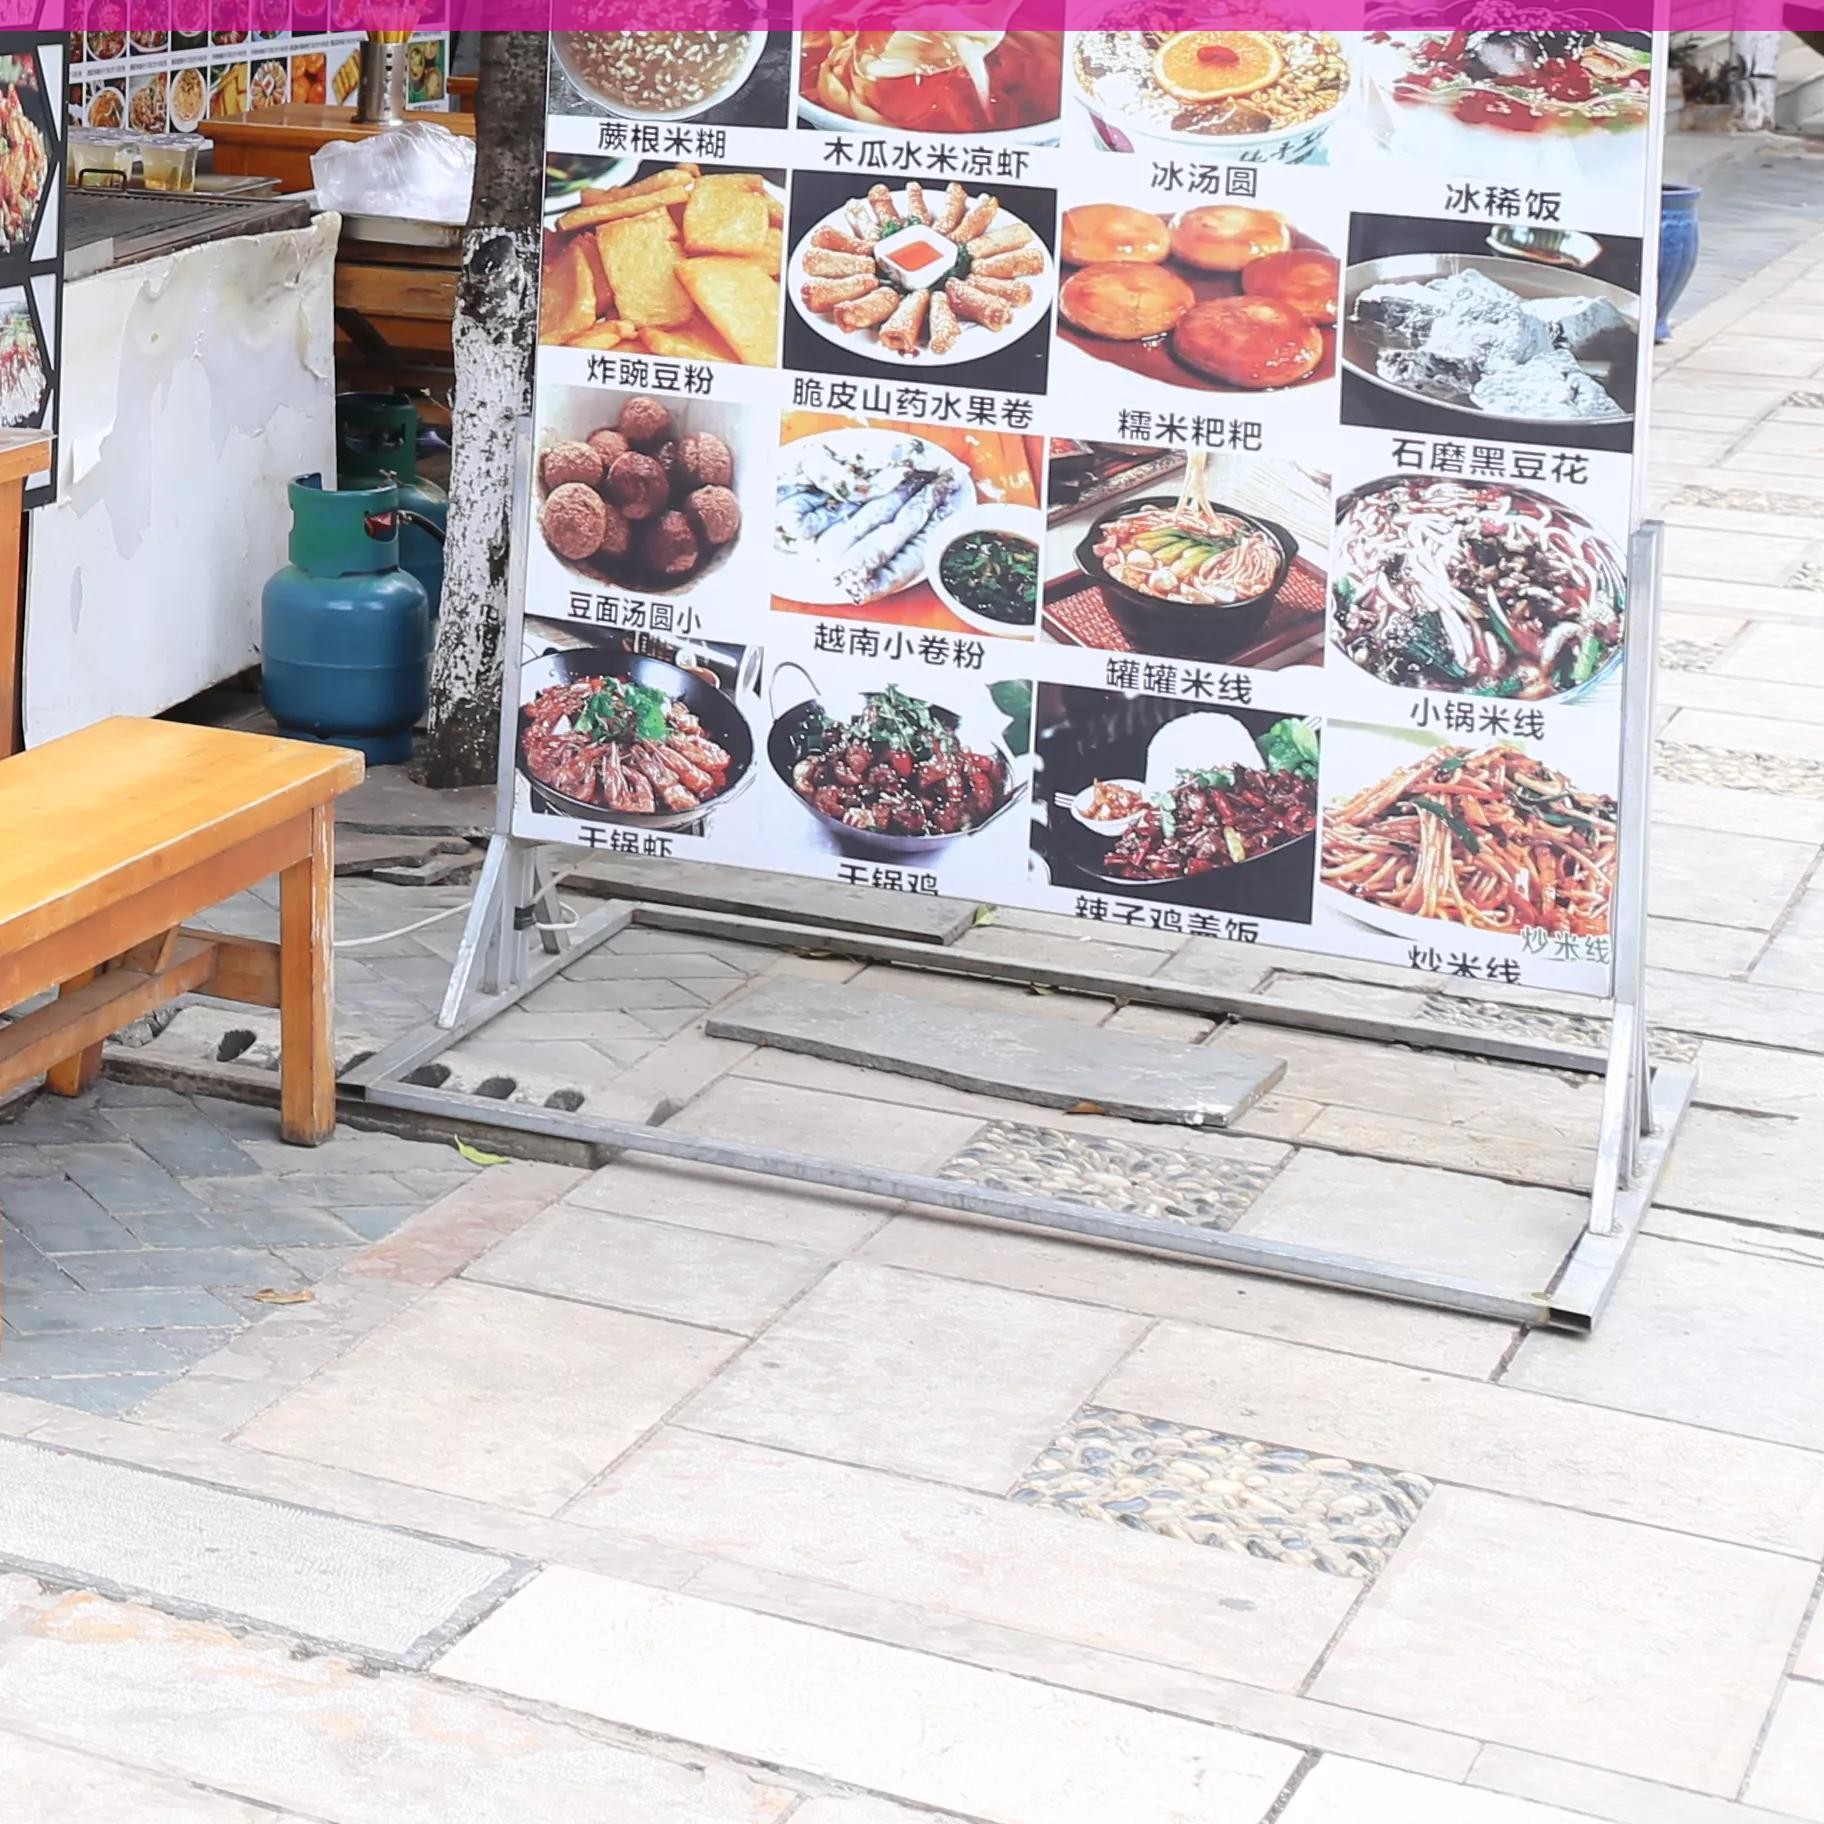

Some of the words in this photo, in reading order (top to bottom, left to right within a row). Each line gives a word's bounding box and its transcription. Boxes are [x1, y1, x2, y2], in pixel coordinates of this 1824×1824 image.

[599, 122, 725, 158] 蕨根米糊
[825, 137, 1028, 178] 木瓜水米凉虾
[1152, 163, 1256, 197] 冰汤圆
[1446, 185, 1560, 221] 冰稀饭
[588, 356, 713, 394] 炸豌豆粉
[794, 378, 1032, 428] 脆皮山药水果卷
[1119, 410, 1261, 450] 糯米粑粑
[1393, 439, 1587, 484] 石磨黑豆花
[568, 592, 700, 640] 豆面汤圆小
[815, 624, 989, 669] 越南小卷粉
[1107, 659, 1251, 704] 罐罐米线
[1412, 692, 1543, 739] 小锅米线
[578, 826, 673, 857] 干锅虾
[1074, 895, 1260, 944] 辣子鸡盖饭
[1520, 926, 1611, 964] 炒米线
